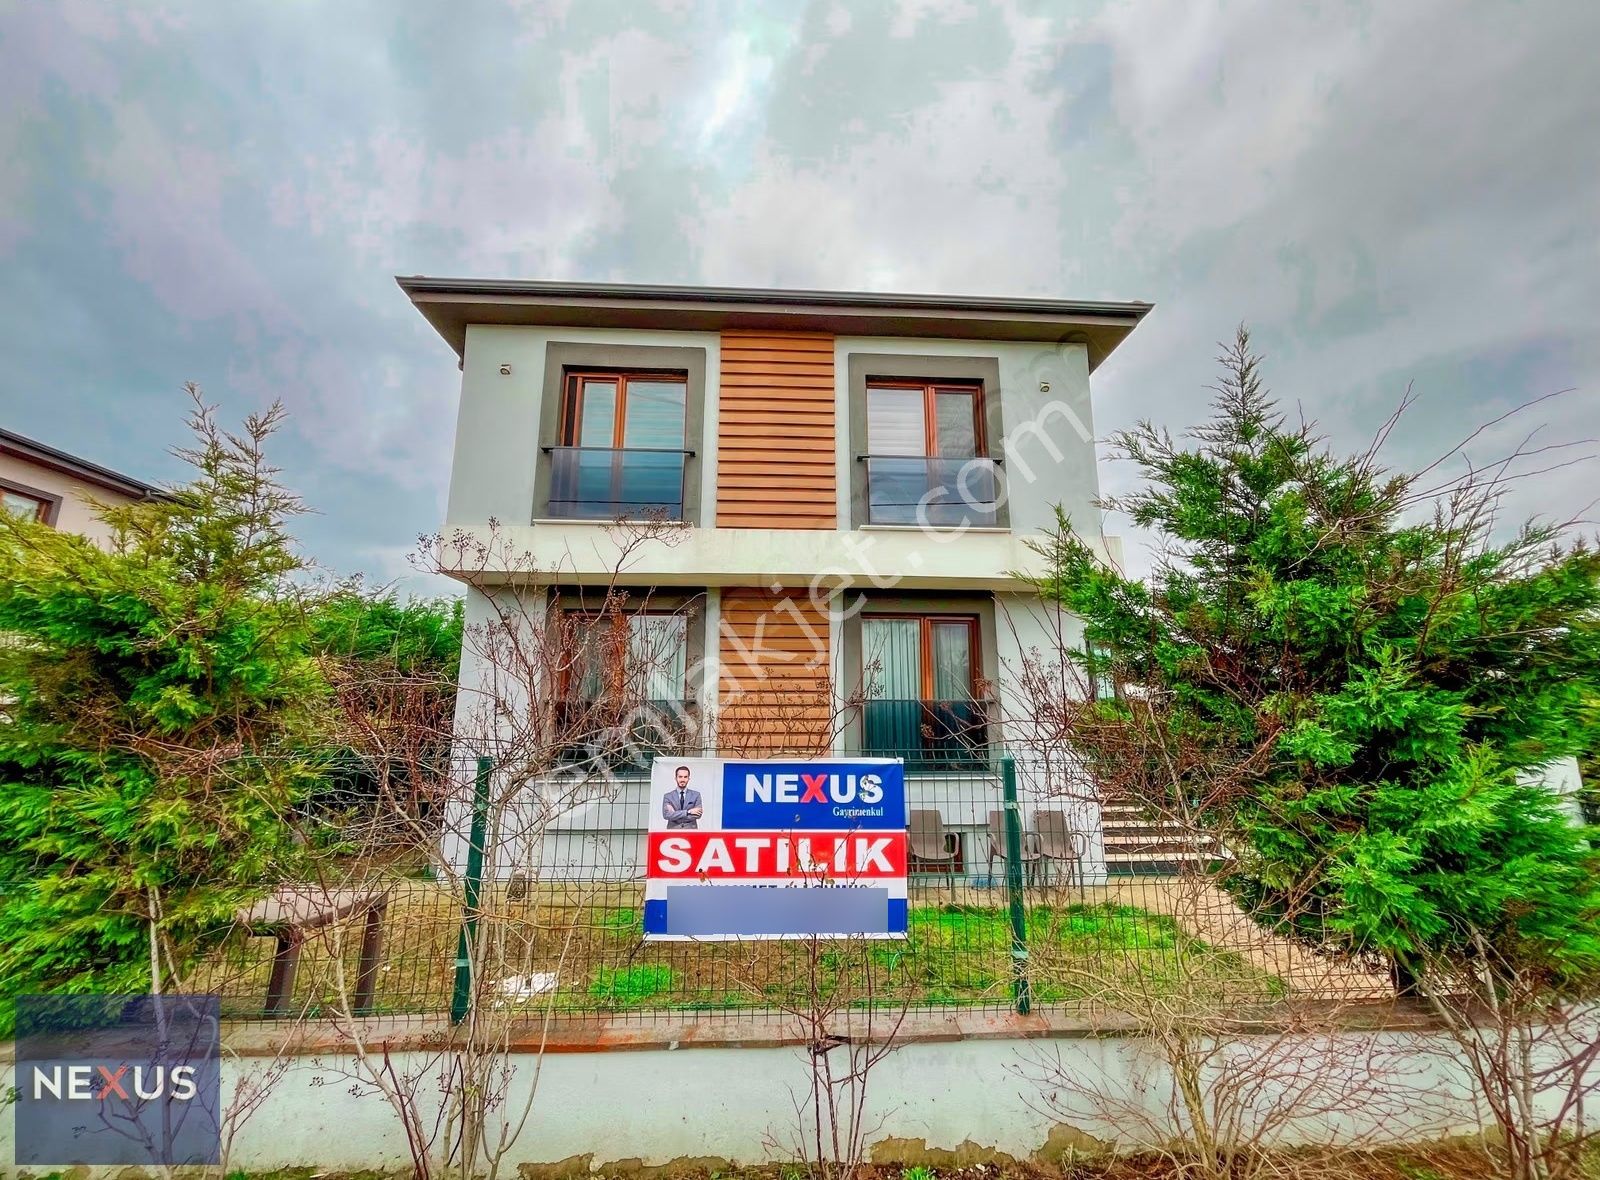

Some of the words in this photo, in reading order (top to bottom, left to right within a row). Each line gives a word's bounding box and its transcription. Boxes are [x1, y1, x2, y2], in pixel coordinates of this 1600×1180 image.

[745, 774, 883, 803] NEXUS
[832, 806, 884, 818] Gayrimenkul
[657, 837, 895, 873] SATILIK
